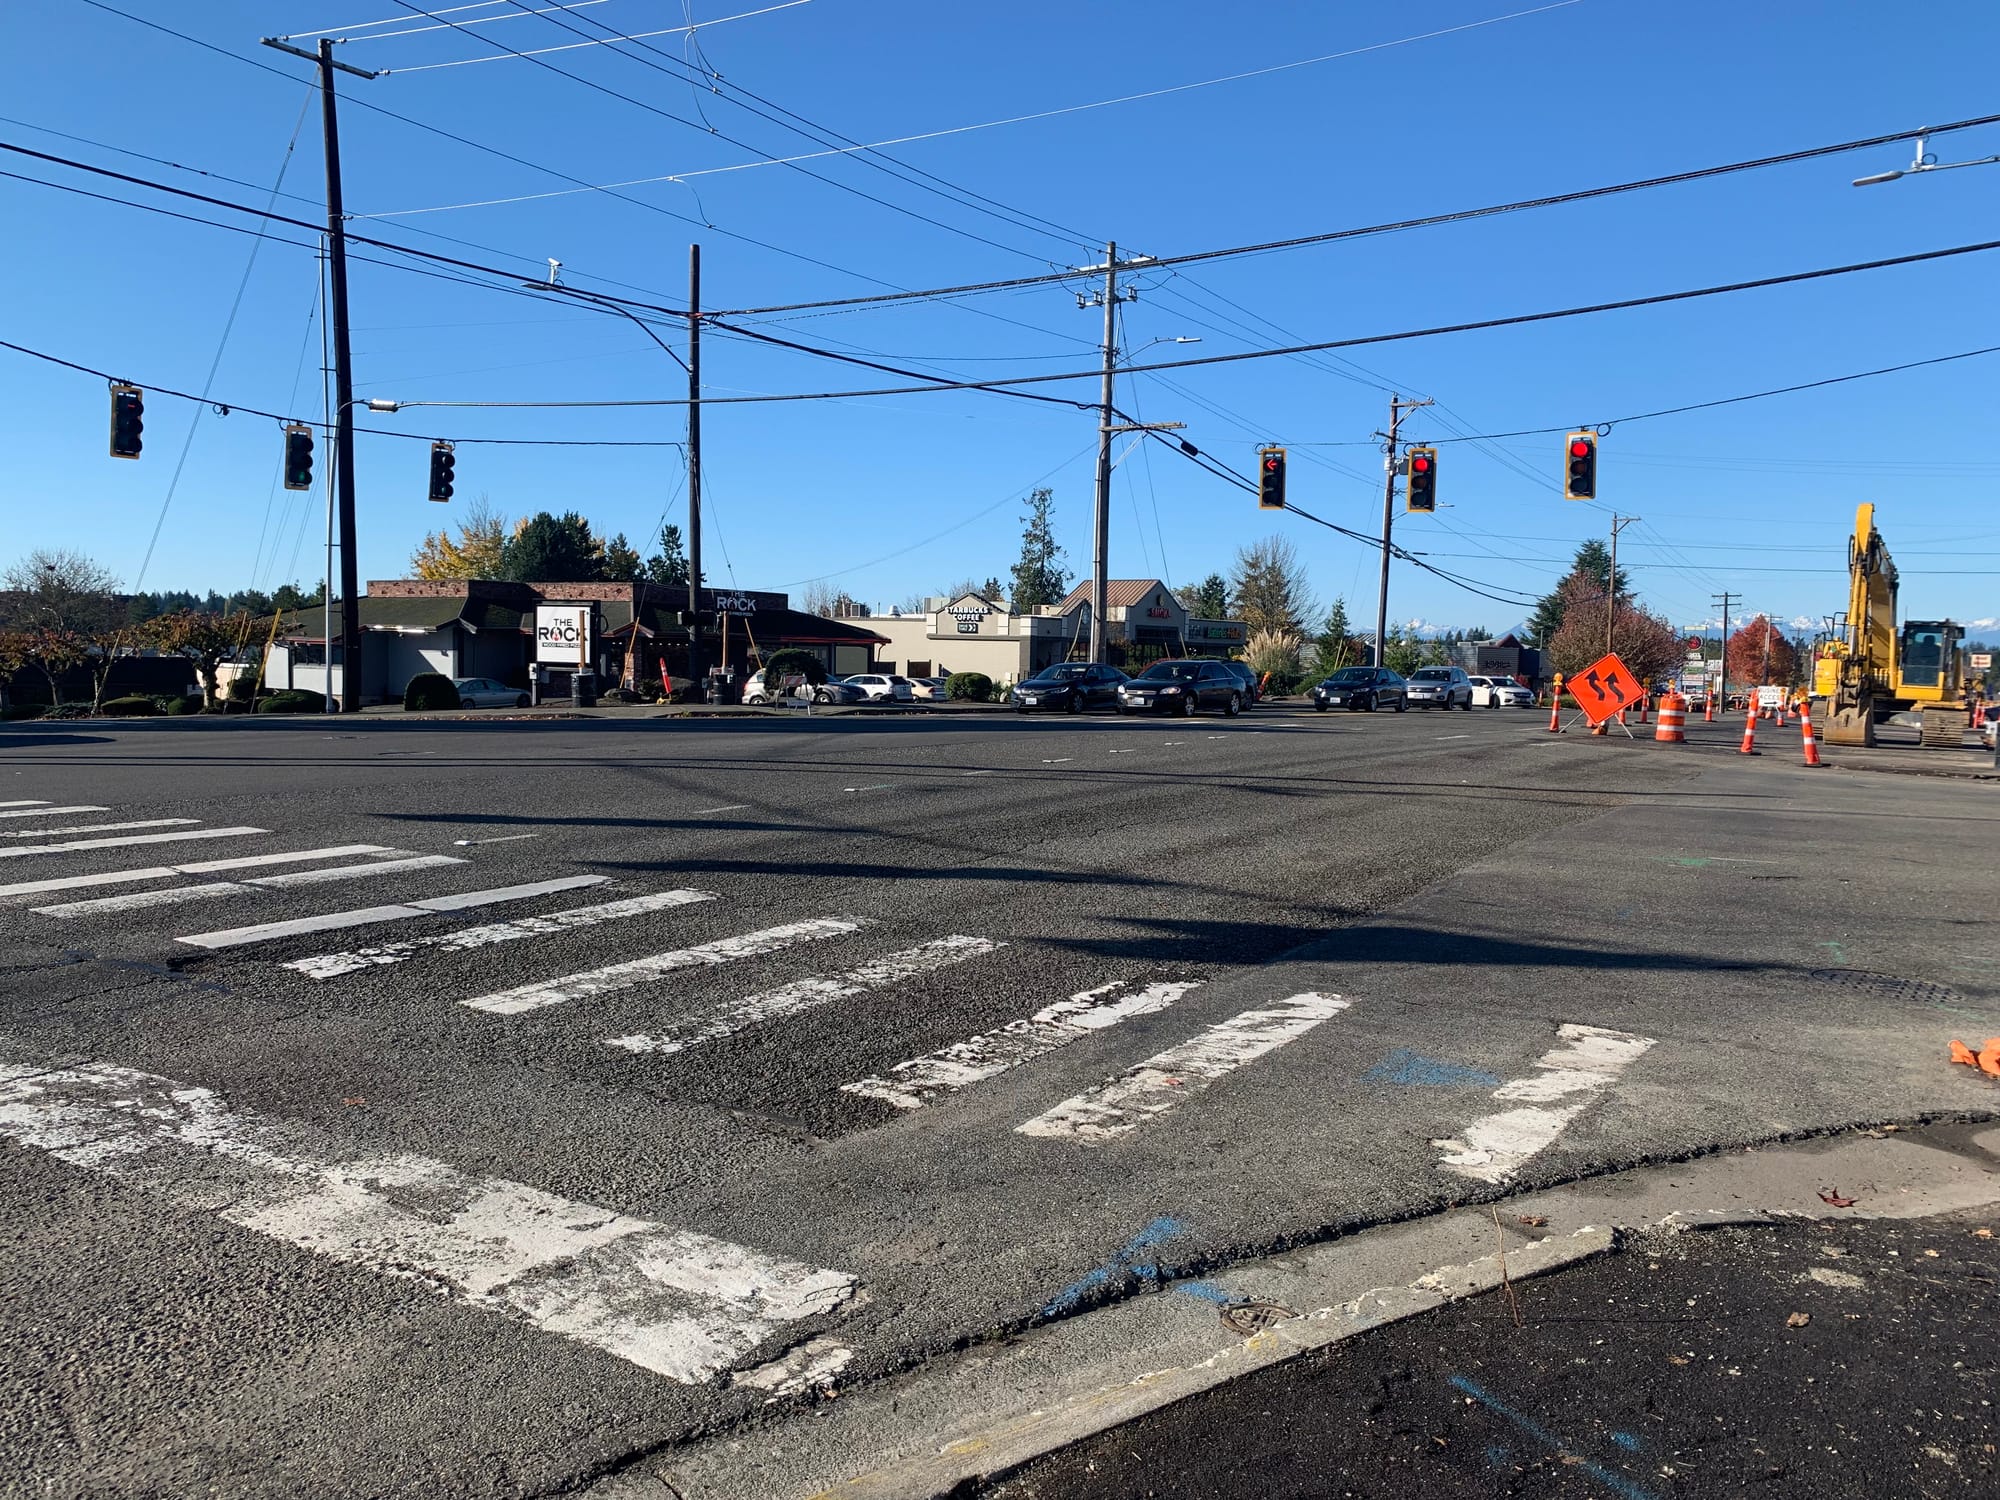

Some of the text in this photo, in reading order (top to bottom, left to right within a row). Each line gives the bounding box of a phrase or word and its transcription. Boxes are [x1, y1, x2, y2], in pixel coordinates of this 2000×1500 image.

[716, 596, 757, 612] ROCK
[944, 606, 989, 614] STARBUCKS
[953, 613, 980, 621] COFFEE
[553, 618, 573, 627] THE
[538, 626, 588, 642] ROCK
